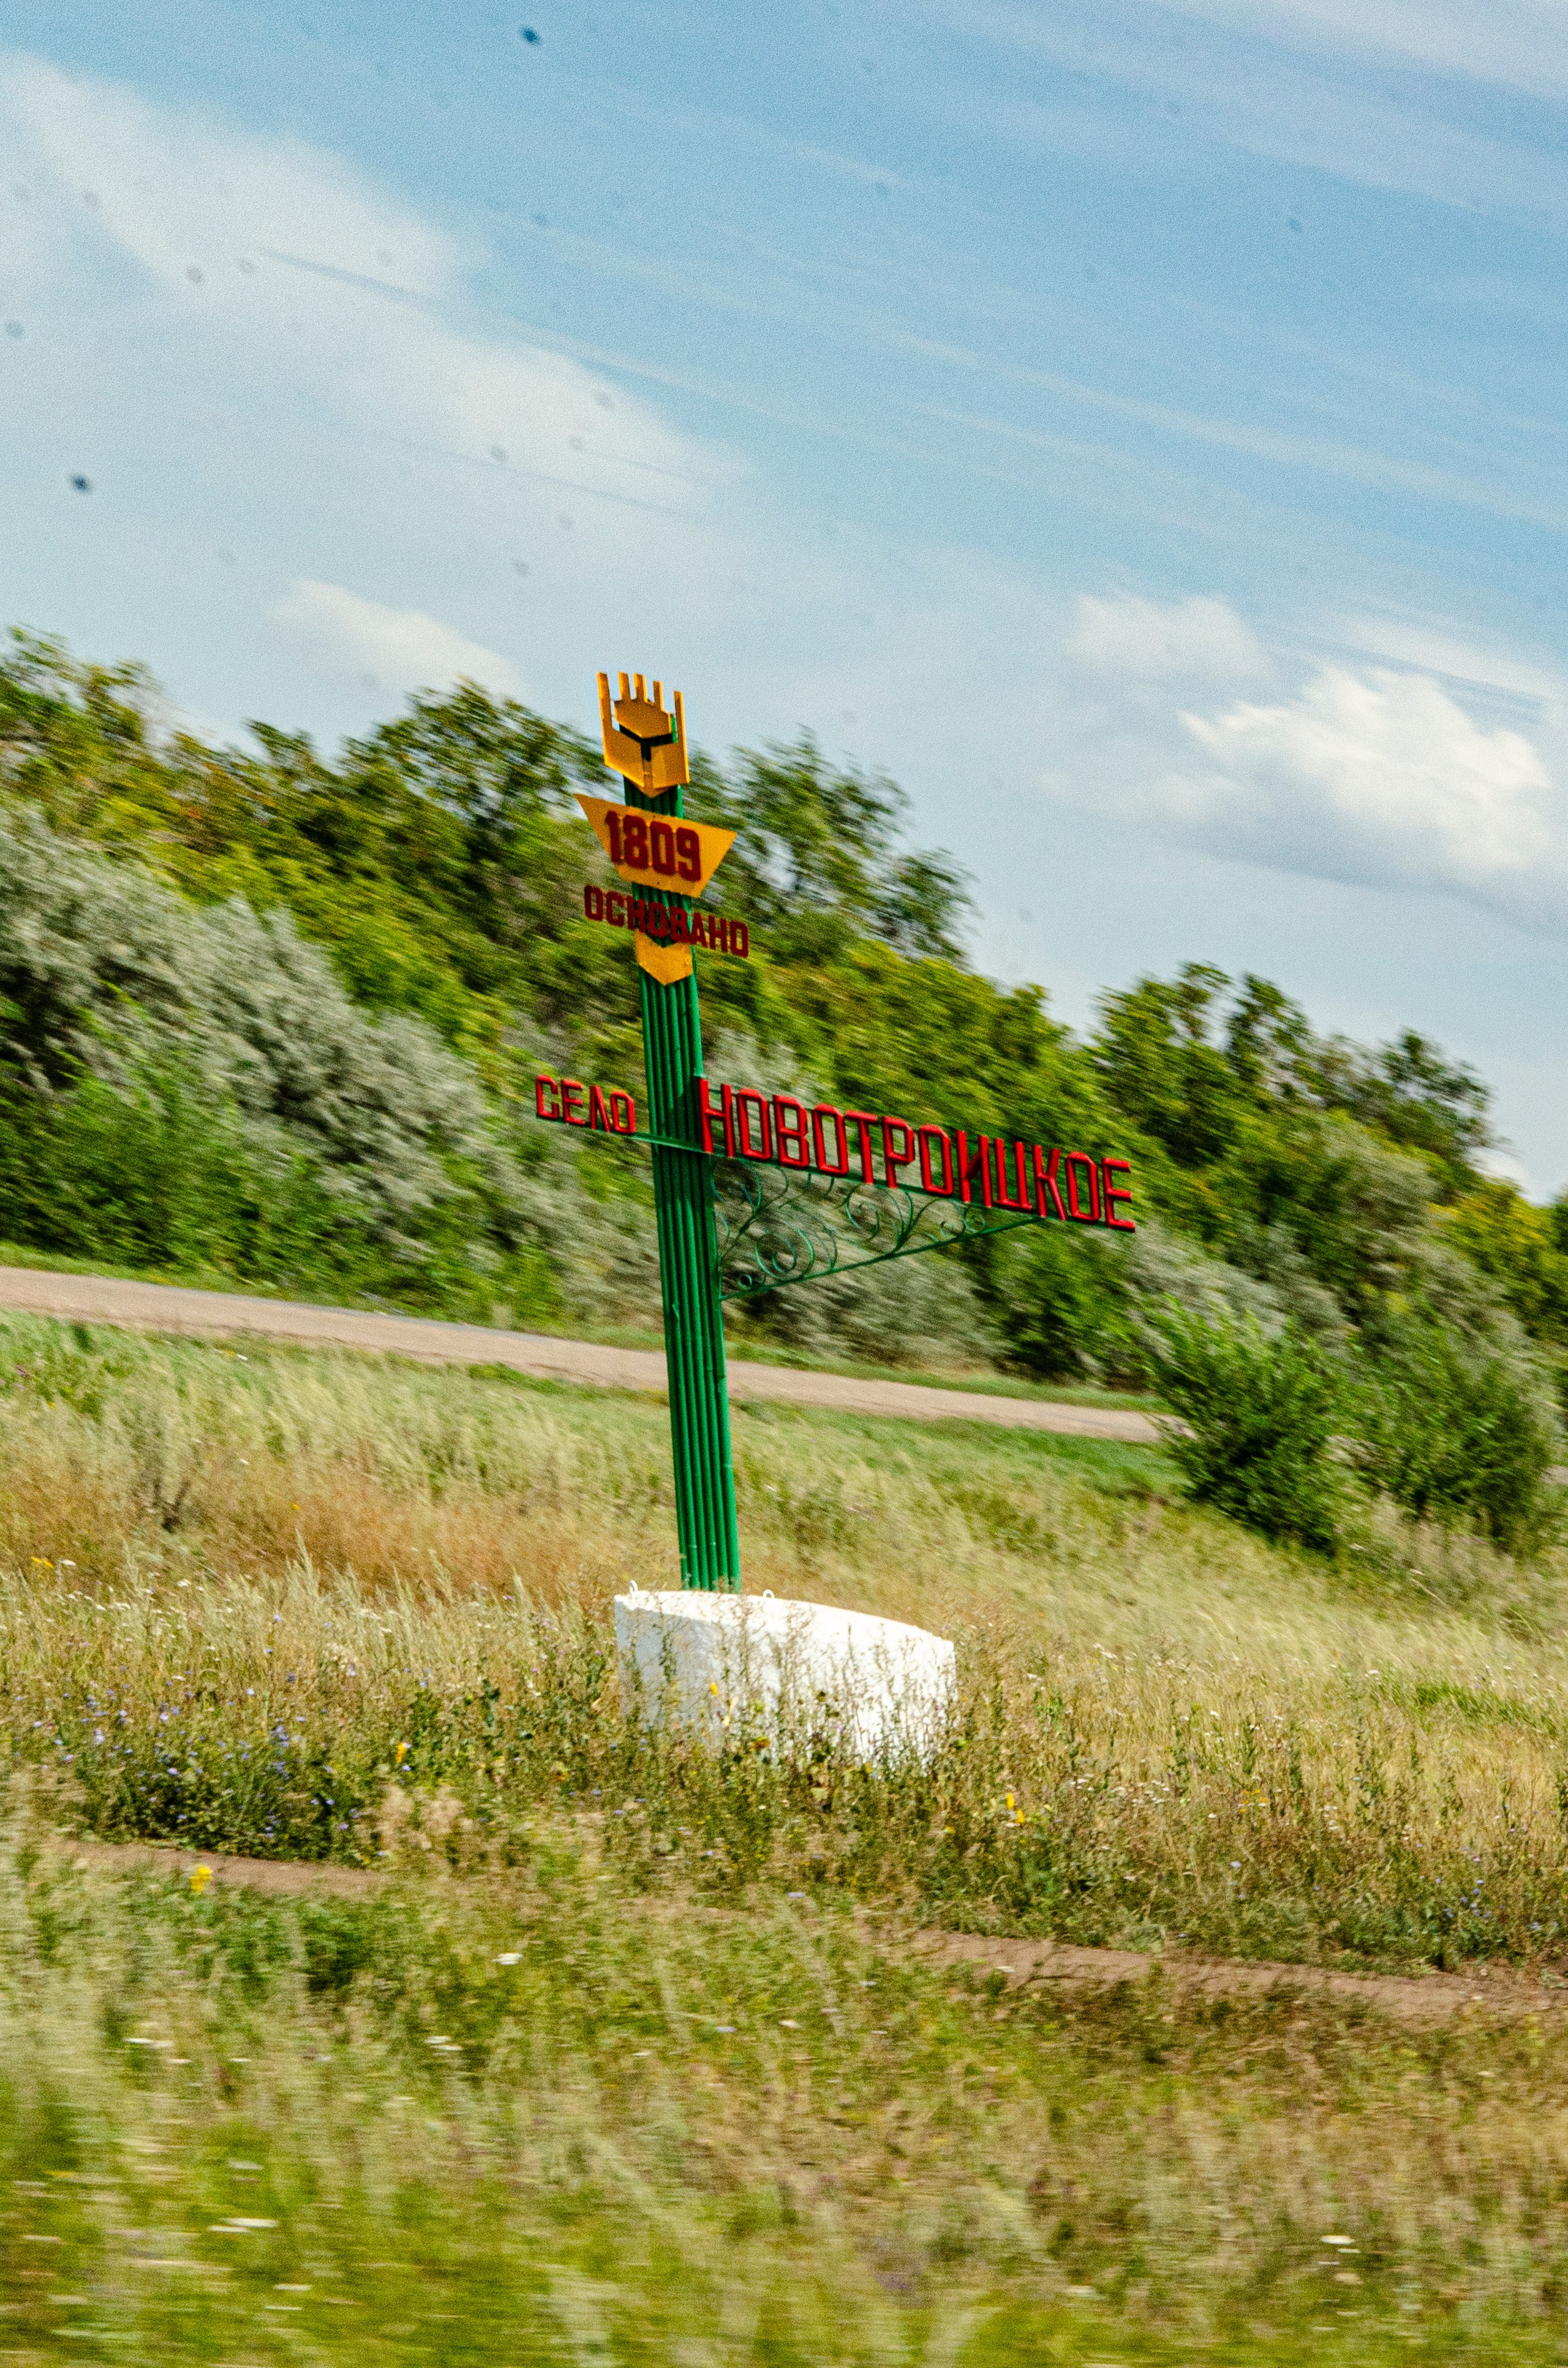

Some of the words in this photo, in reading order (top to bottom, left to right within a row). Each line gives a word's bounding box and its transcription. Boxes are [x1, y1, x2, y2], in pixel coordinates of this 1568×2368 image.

[605, 810, 701, 882] 1809
[584, 885, 749, 958] ОСНОВАНО
[535, 1074, 636, 1134] СЕЛО
[698, 1078, 1136, 1232] НОВОТРОИЦКОЕ
